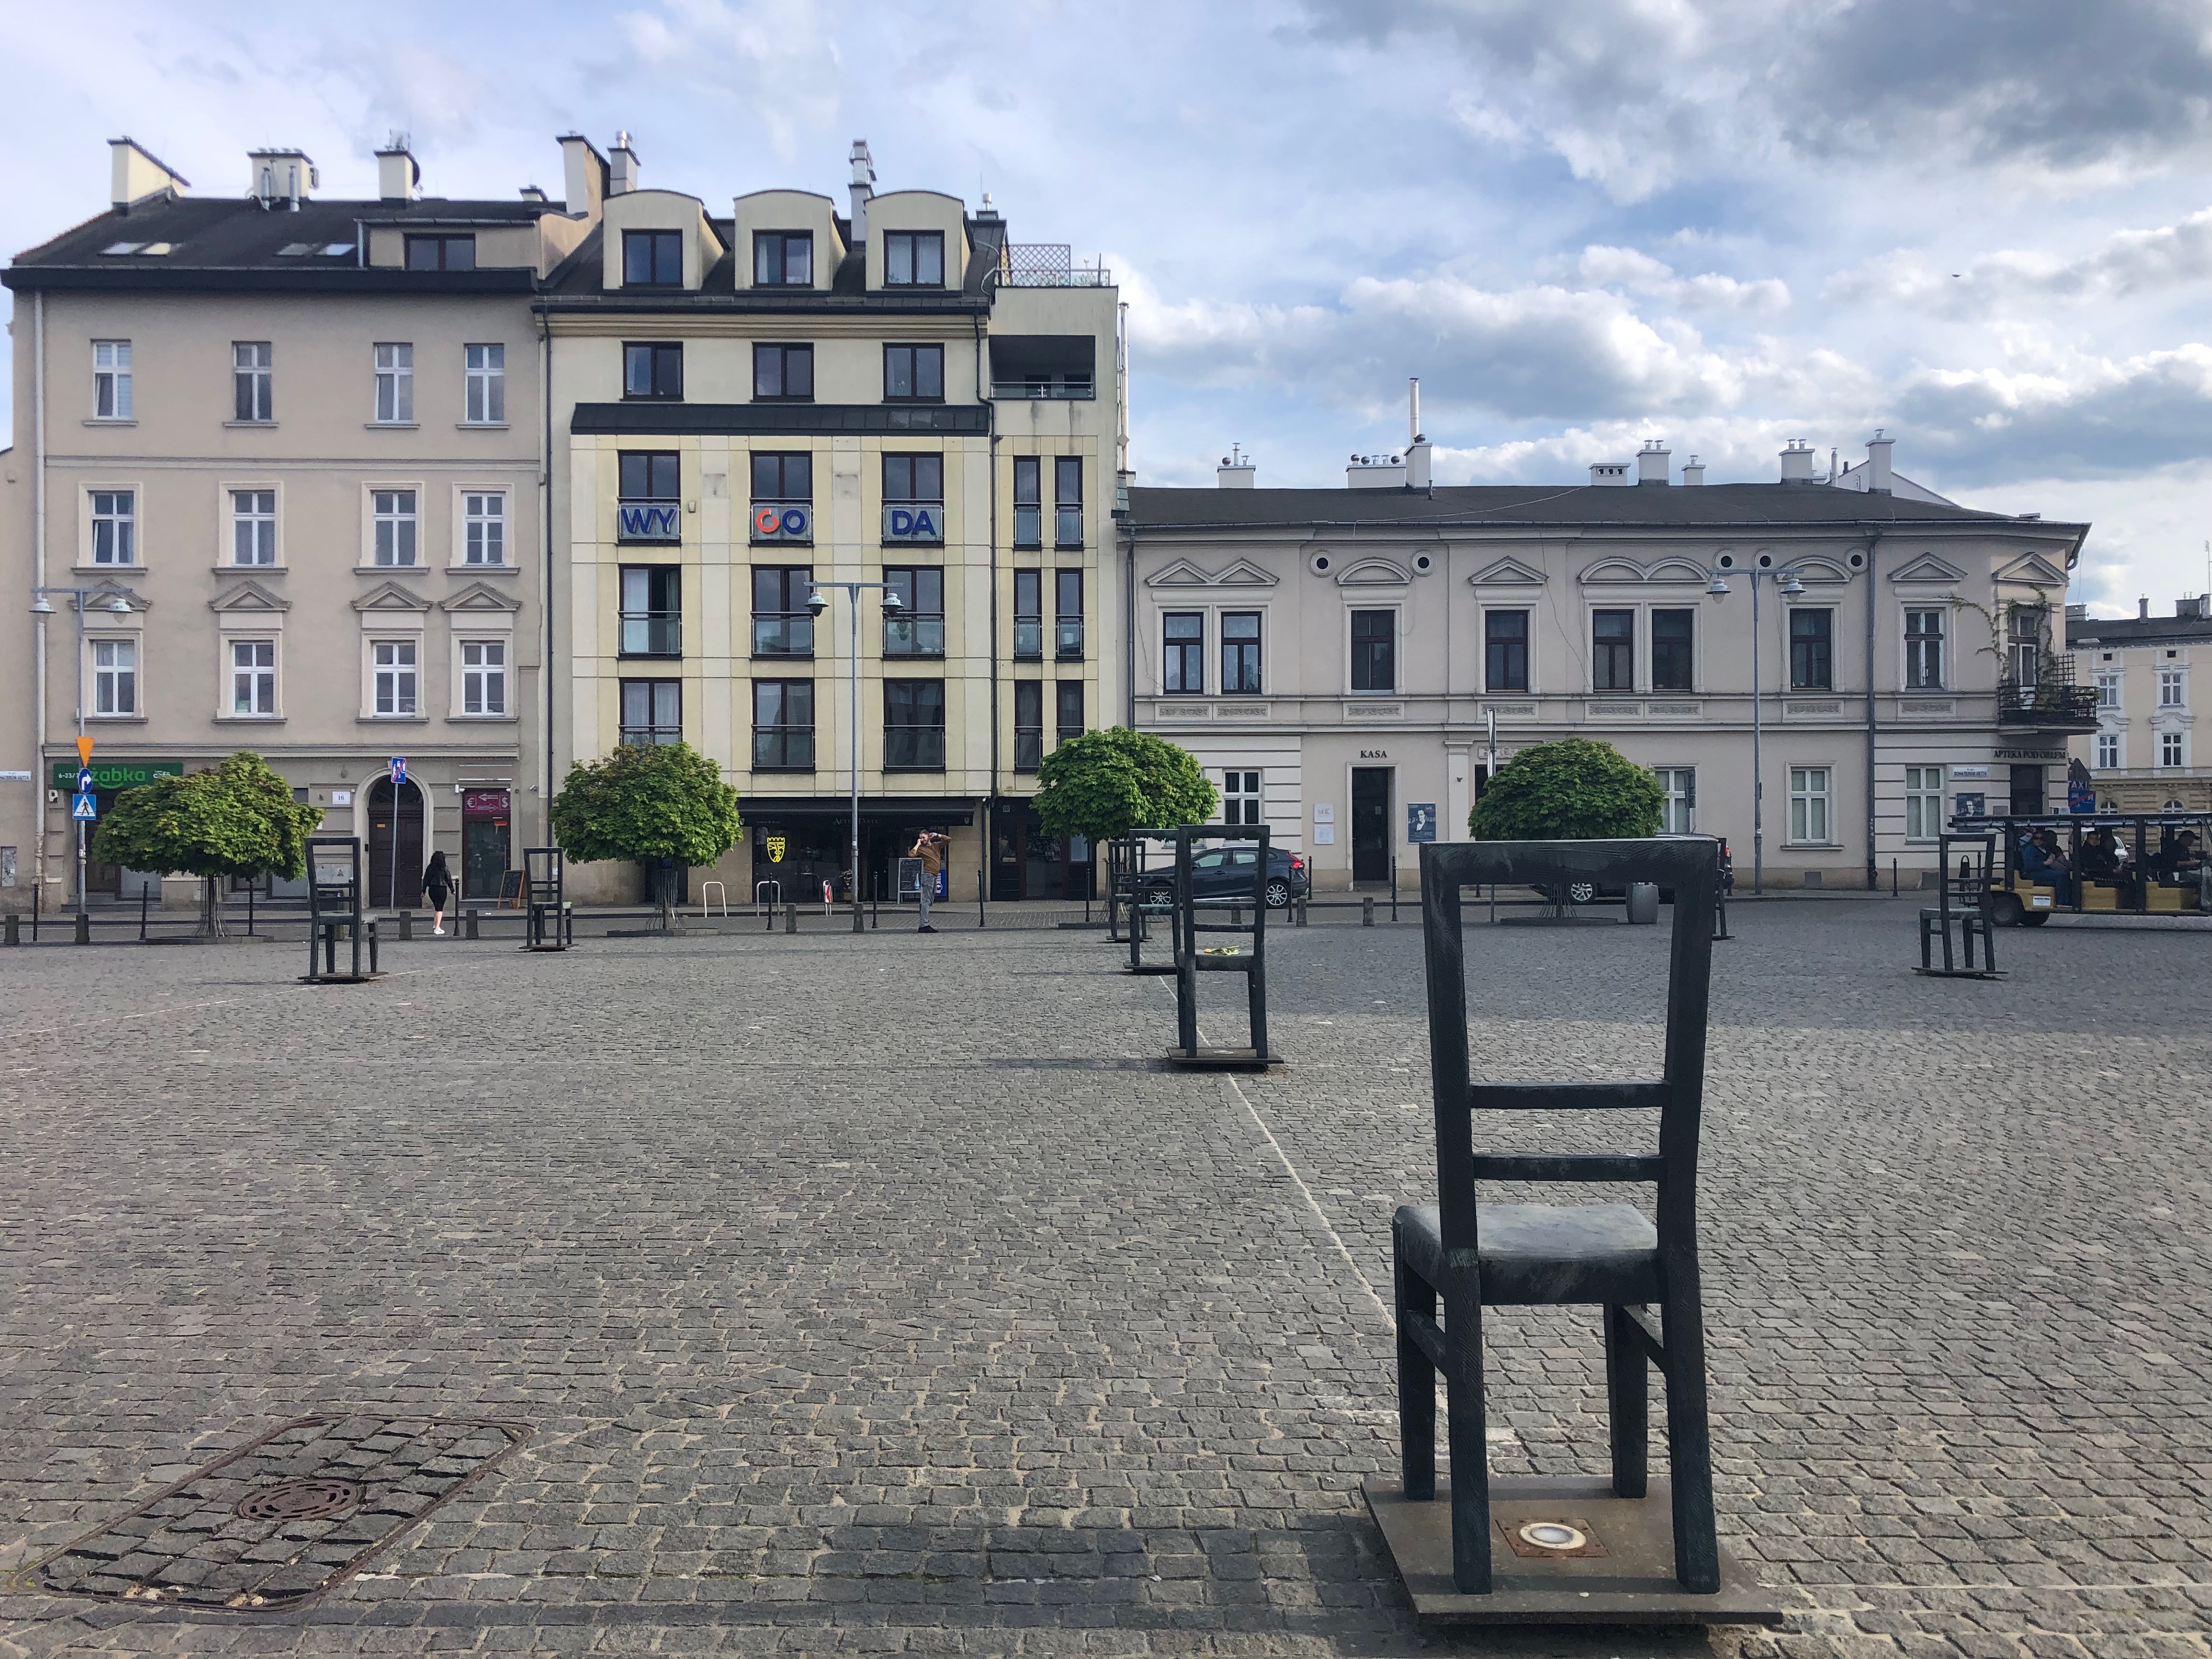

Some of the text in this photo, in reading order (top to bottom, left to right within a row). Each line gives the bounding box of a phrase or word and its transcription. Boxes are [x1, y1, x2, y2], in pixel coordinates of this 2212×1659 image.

[621, 509, 675, 534] WY
[892, 510, 936, 535] DA
[1361, 750, 1387, 758] KASA
[92, 768, 146, 782] żabka
[2068, 781, 2087, 789] TAXI
